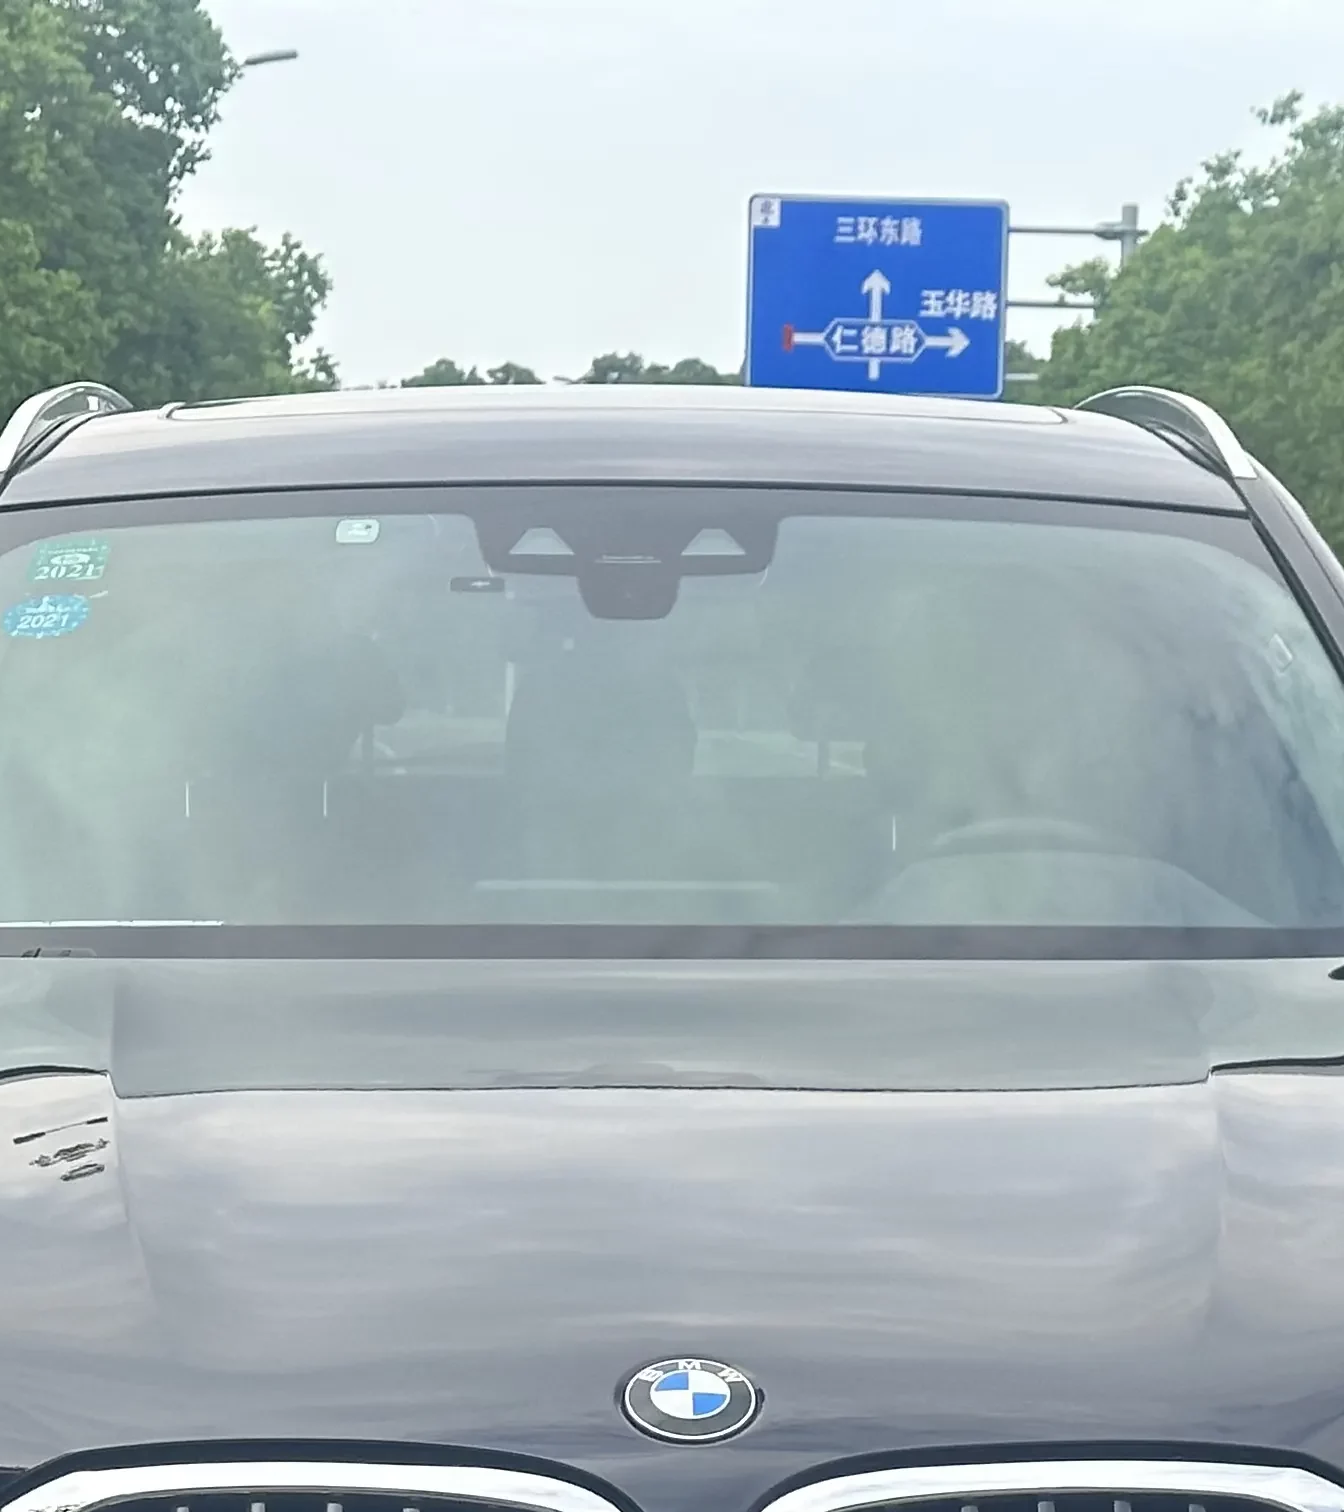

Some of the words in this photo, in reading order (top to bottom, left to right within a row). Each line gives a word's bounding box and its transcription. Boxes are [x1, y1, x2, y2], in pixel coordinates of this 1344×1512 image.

[833, 216, 923, 246] 三环东路
[918, 289, 999, 321] 玉华路
[832, 325, 919, 355] 仁德路
[34, 563, 95, 581] 2021
[16, 613, 70, 629] 2021
[637, 1360, 746, 1383] BMW
